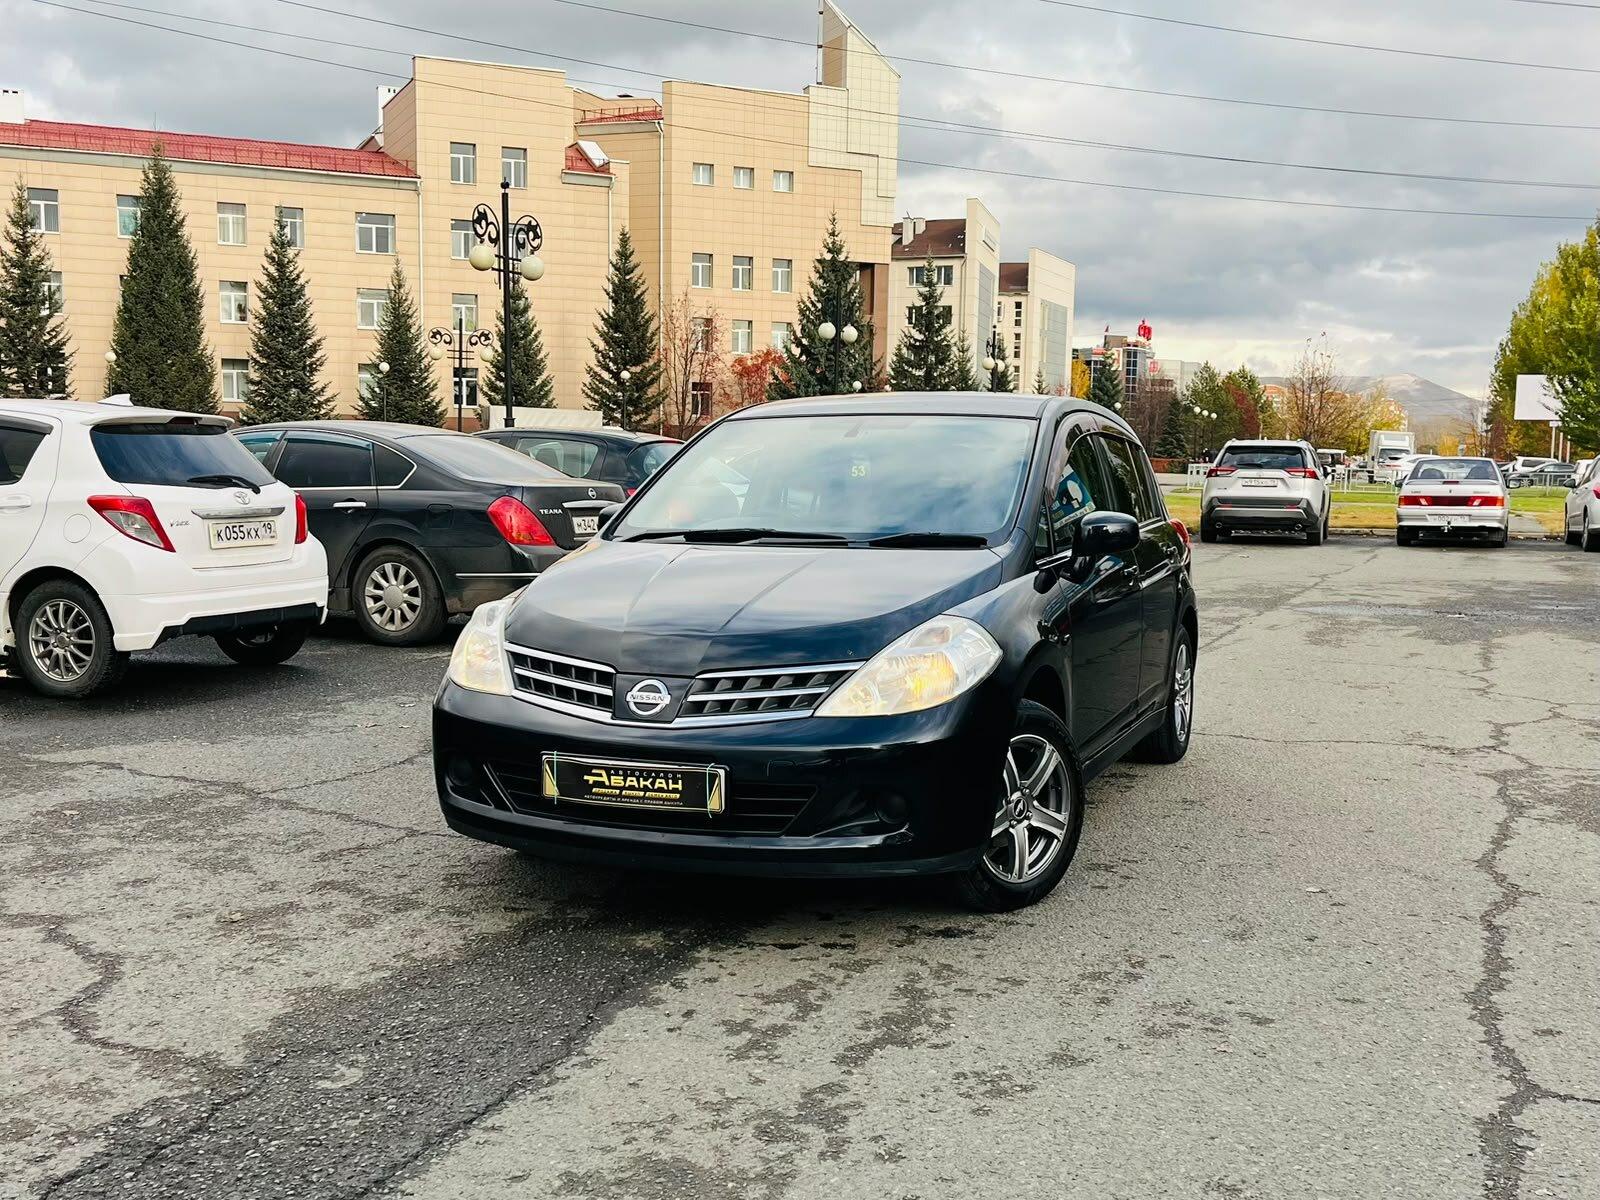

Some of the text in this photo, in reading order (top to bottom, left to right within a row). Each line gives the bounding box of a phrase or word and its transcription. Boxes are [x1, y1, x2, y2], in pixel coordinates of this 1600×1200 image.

[851, 465, 865, 477] 53
[262, 522, 273, 534] 19
[630, 694, 664, 702] NISSAN
[583, 769, 682, 791] АБАКАН
[611, 770, 682, 778] АВТОСАЛОН
